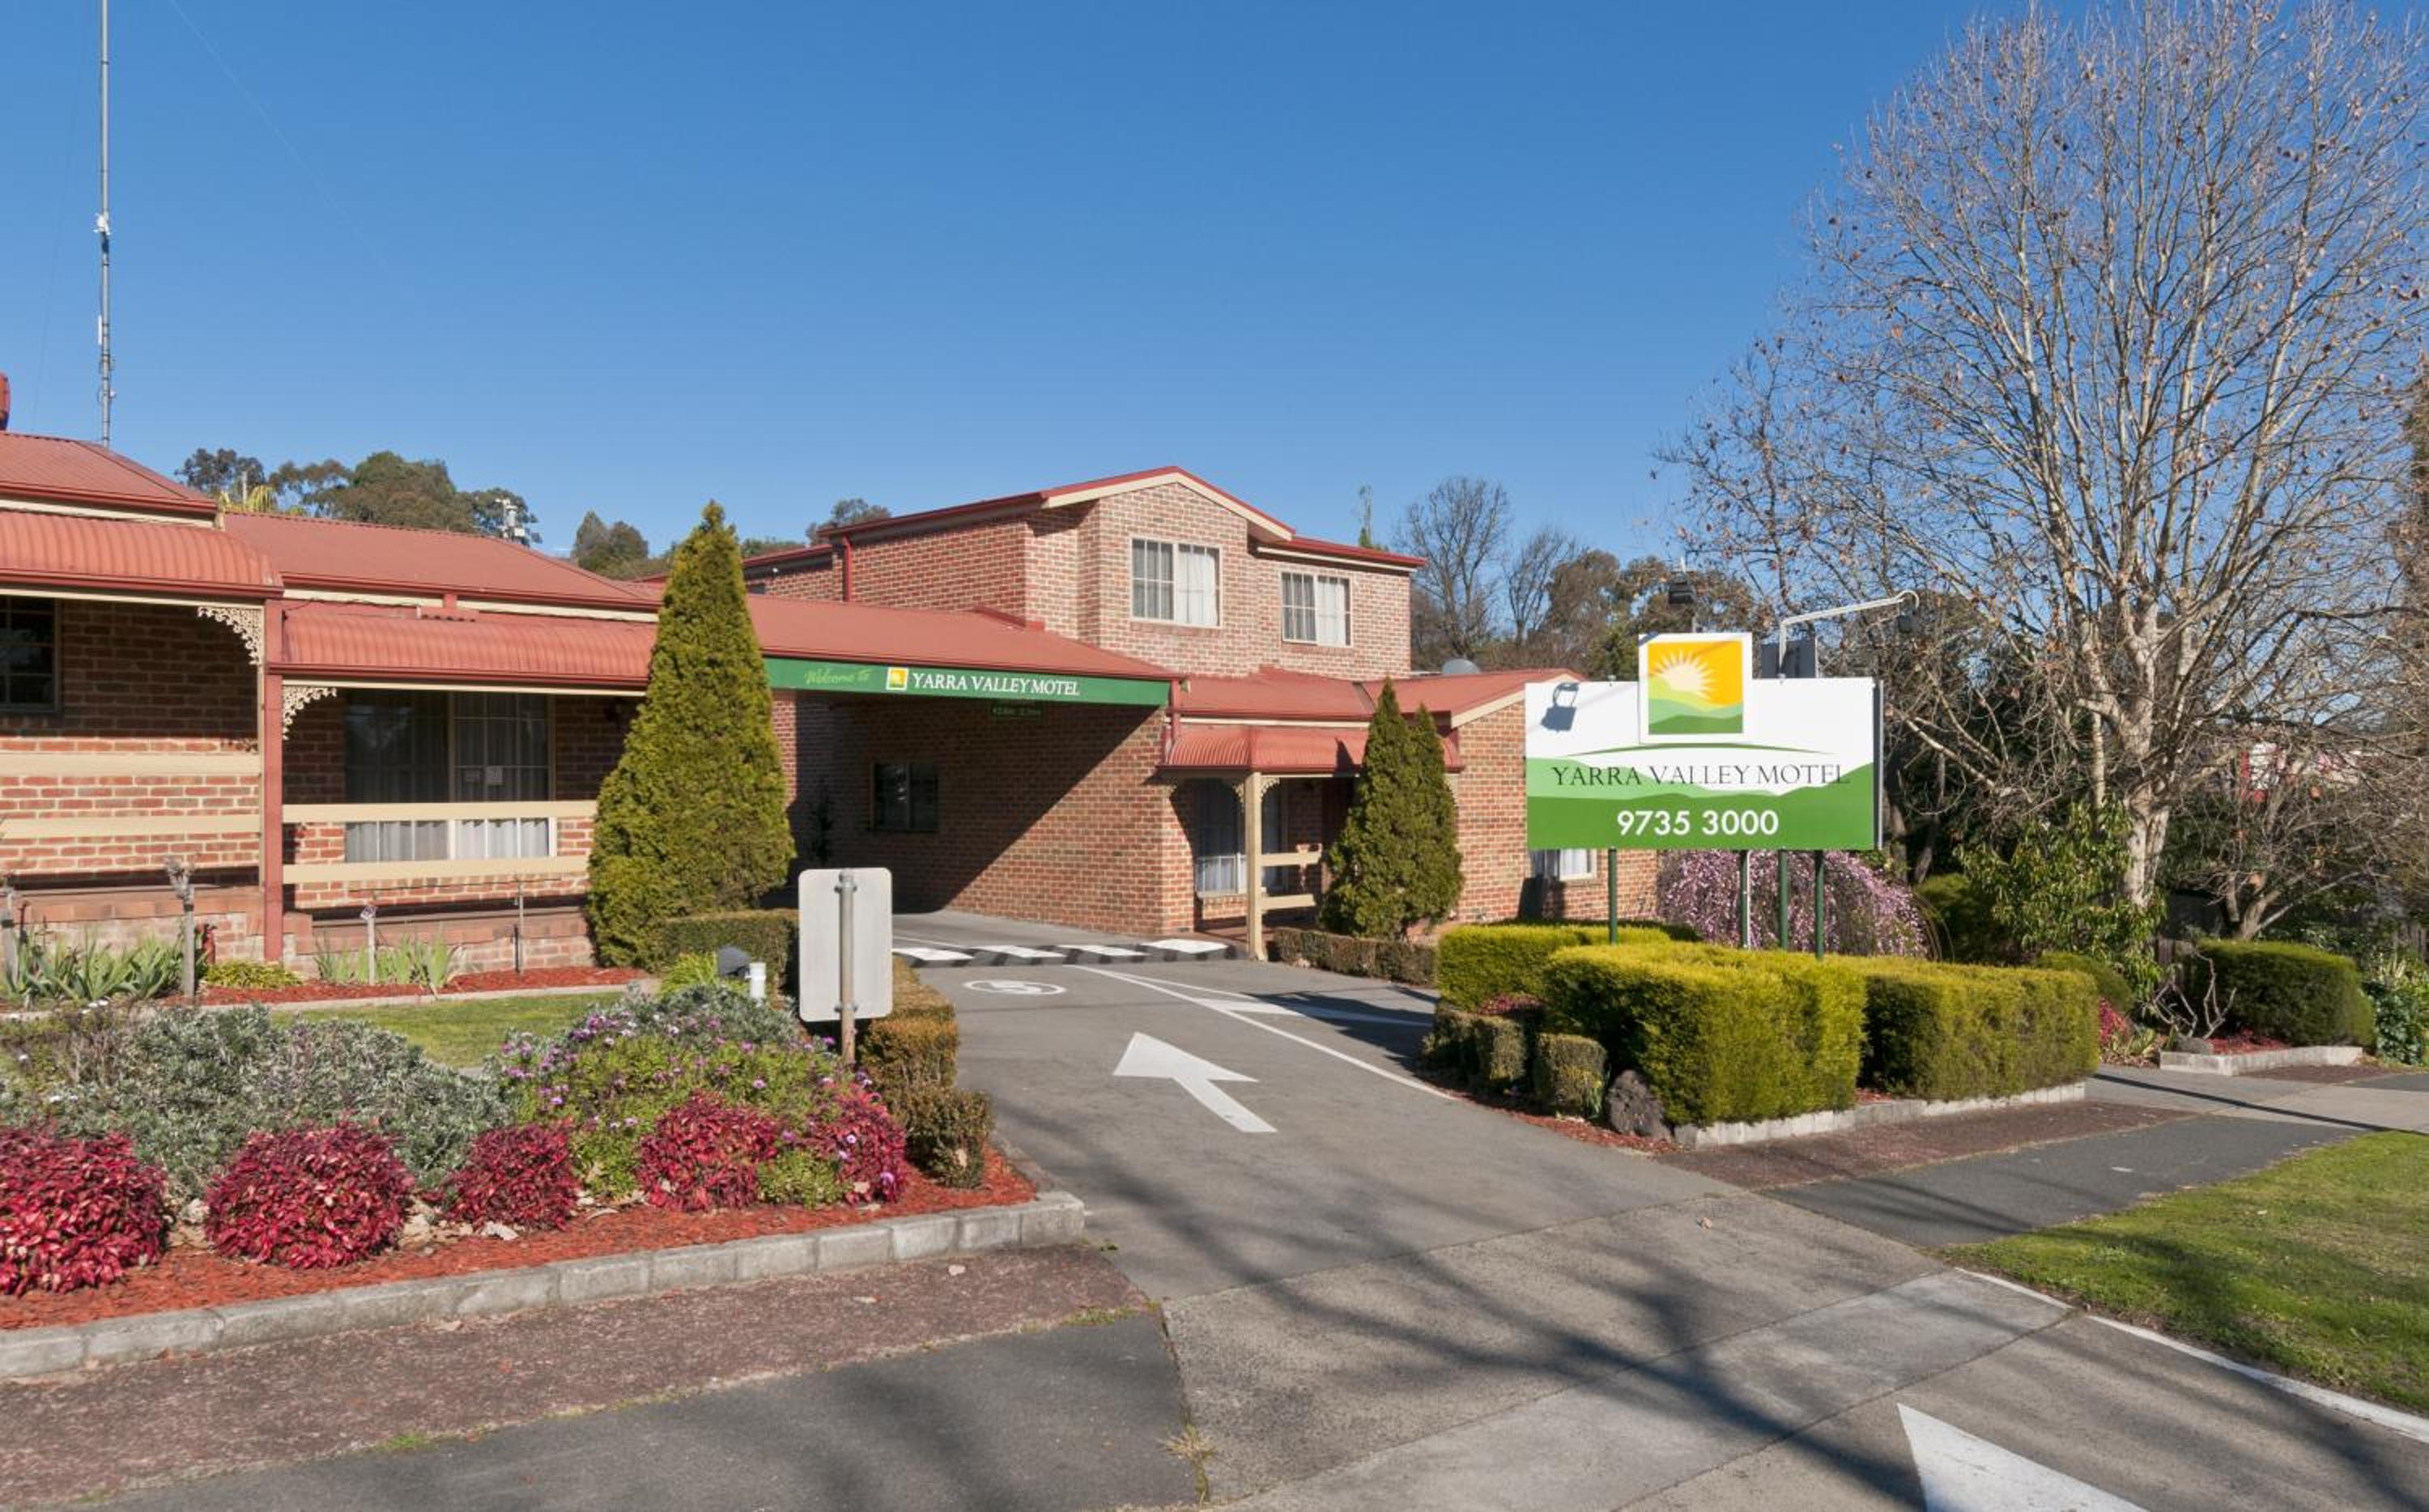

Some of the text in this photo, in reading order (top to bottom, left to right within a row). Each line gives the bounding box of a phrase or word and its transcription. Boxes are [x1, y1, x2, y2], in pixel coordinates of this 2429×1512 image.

[803, 668, 855, 685] Welcome
[912, 673, 1080, 696] YARRA VALLEY MOTEL
[1552, 764, 1850, 785] YARRA VALLEY MOTEL
[1616, 809, 1779, 836] 9735 3000
